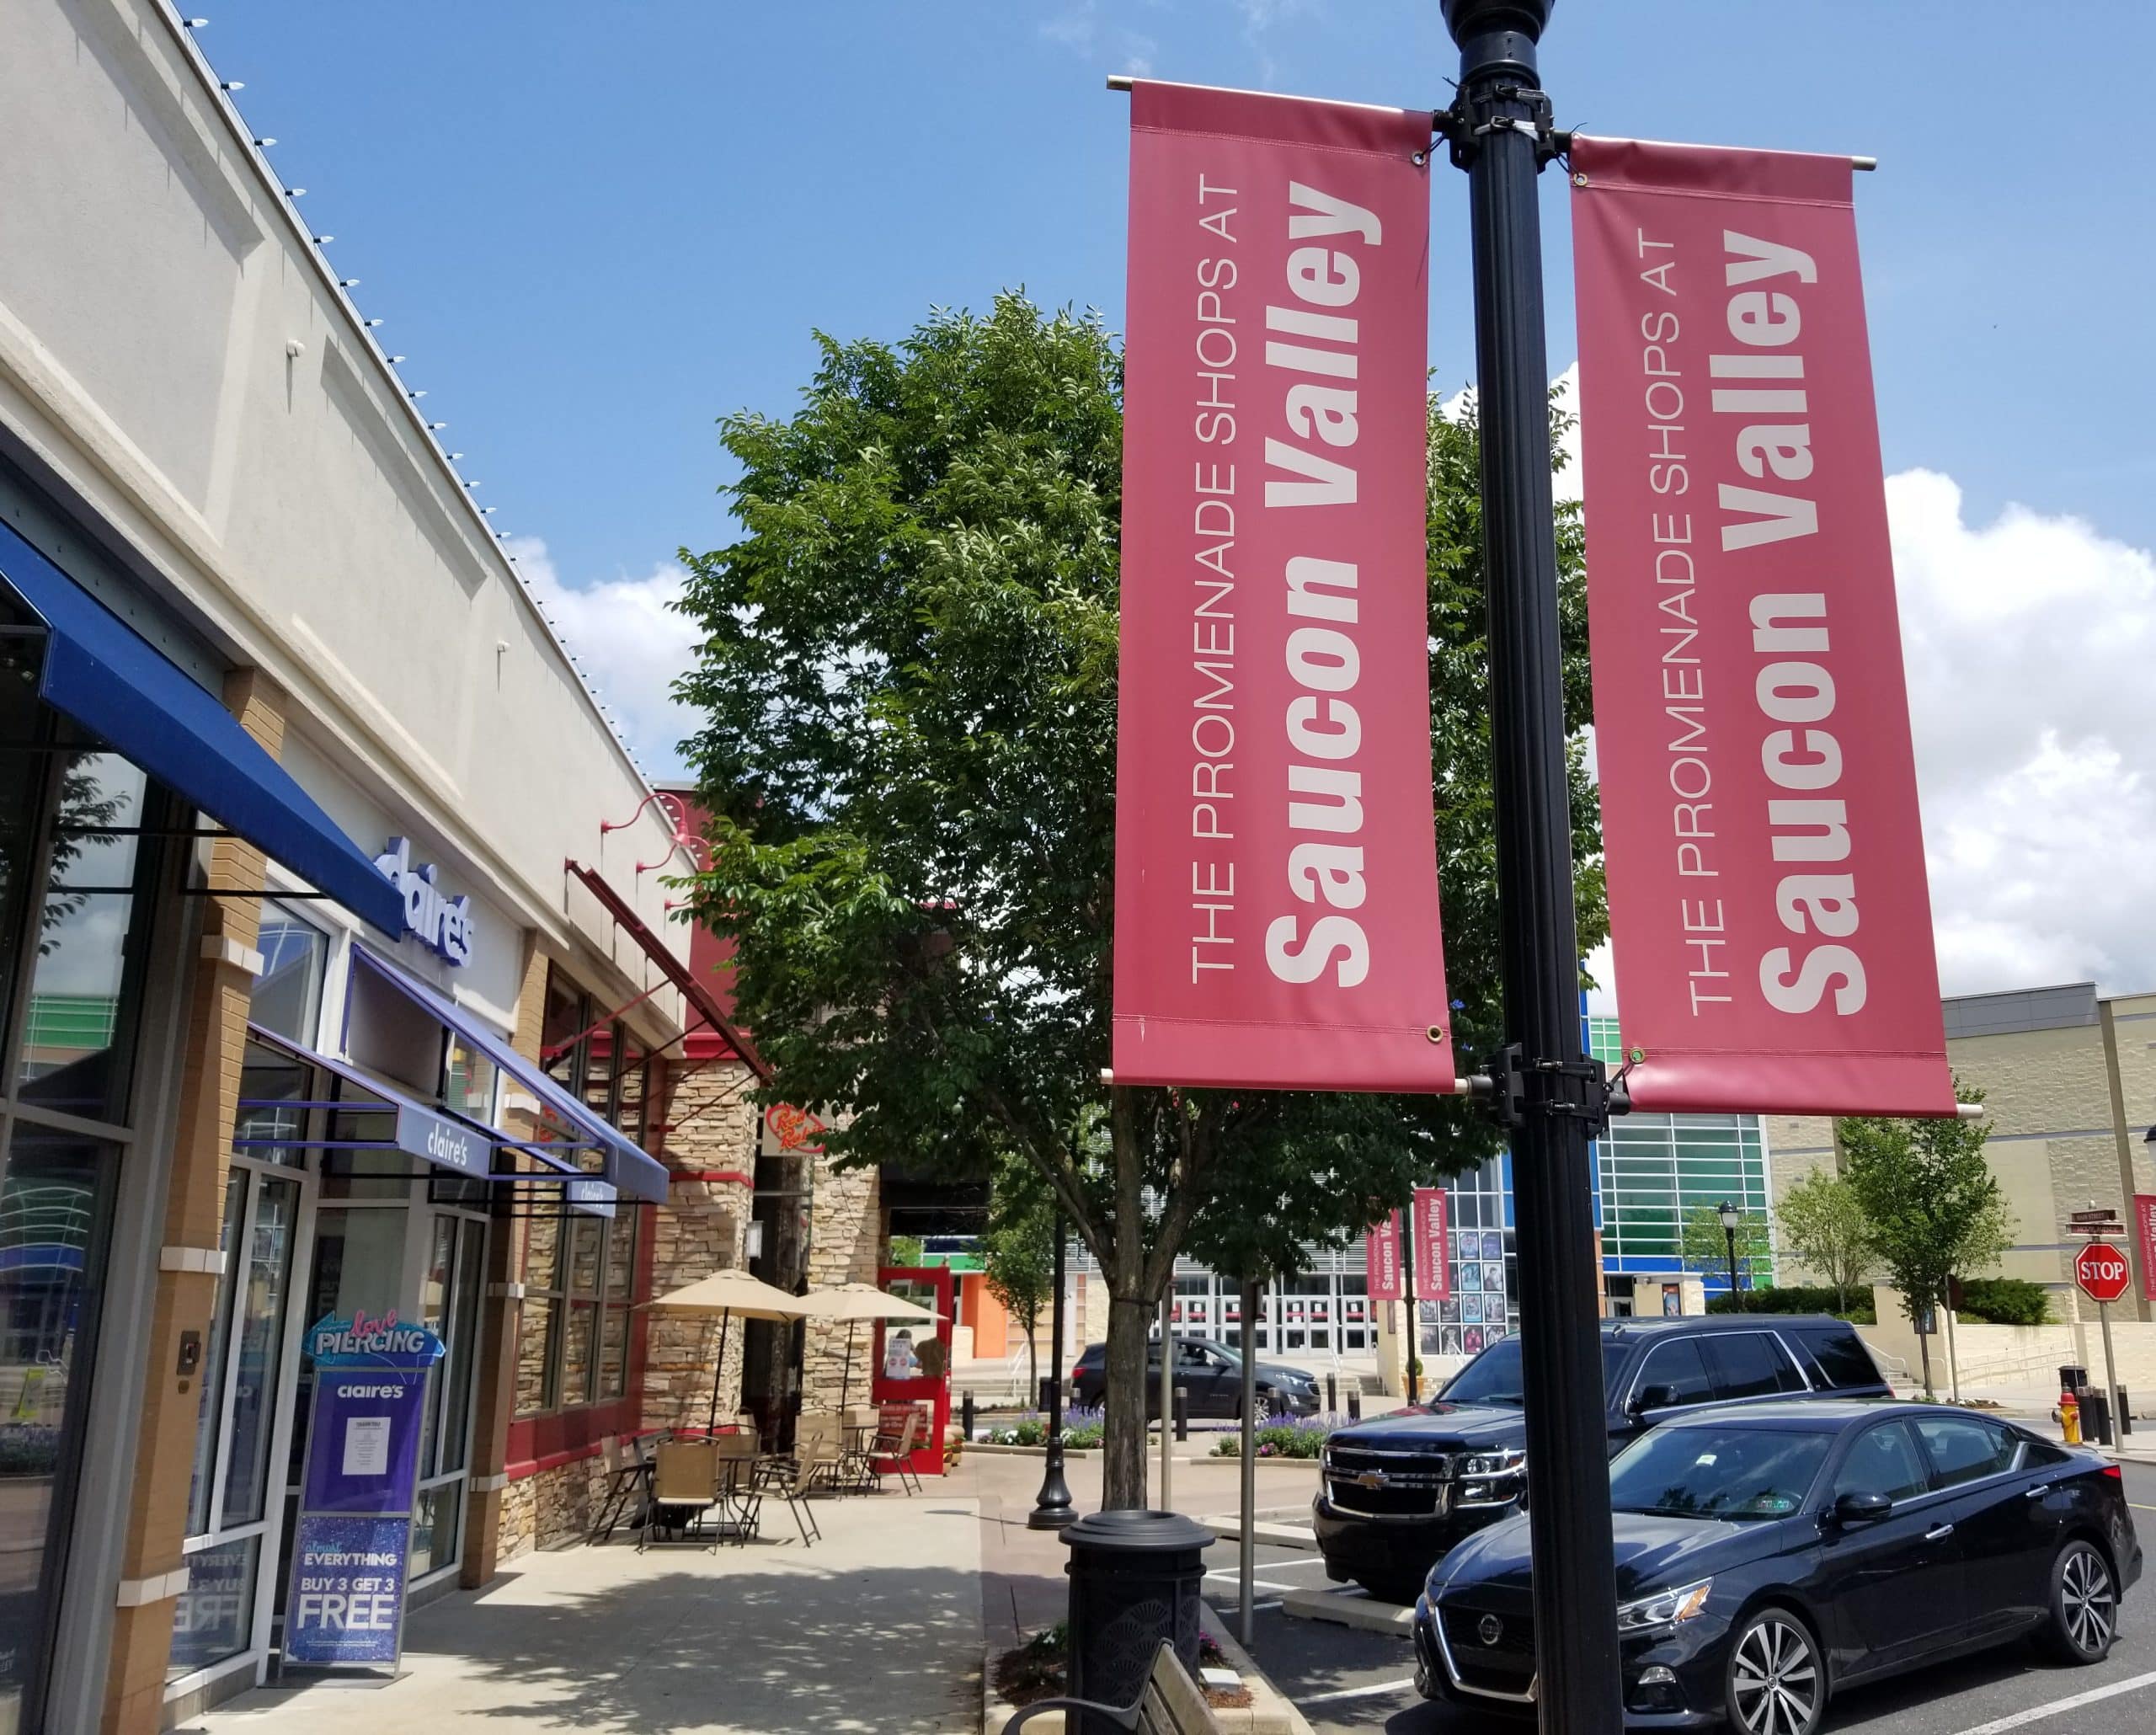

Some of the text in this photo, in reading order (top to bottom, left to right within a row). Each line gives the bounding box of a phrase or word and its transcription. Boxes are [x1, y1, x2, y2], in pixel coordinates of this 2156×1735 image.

[1192, 174, 1238, 985] THE PROMENADE SHOPS AT
[1264, 180, 1382, 988] Saucon Valley
[1638, 227, 1732, 1017] THE PROMENADE SHOPS AT
[1709, 228, 1867, 1017] Saucon Valley
[776, 1107, 806, 1130] Red
[427, 1122, 468, 1167] claire's
[779, 1123, 822, 1152] Rob
[1428, 1198, 1443, 1290] Saucon Valley
[1382, 1241, 1394, 1290] Saucon
[2081, 1262, 2124, 1280] STOP
[350, 1309, 398, 1337] love
[316, 1330, 424, 1355] PIERCING
[337, 1385, 404, 1398] claire's
[304, 1552, 398, 1566] EVERYTHING
[301, 1578, 395, 1592] BUY 3 GET 3
[296, 1594, 394, 1630] FREE
